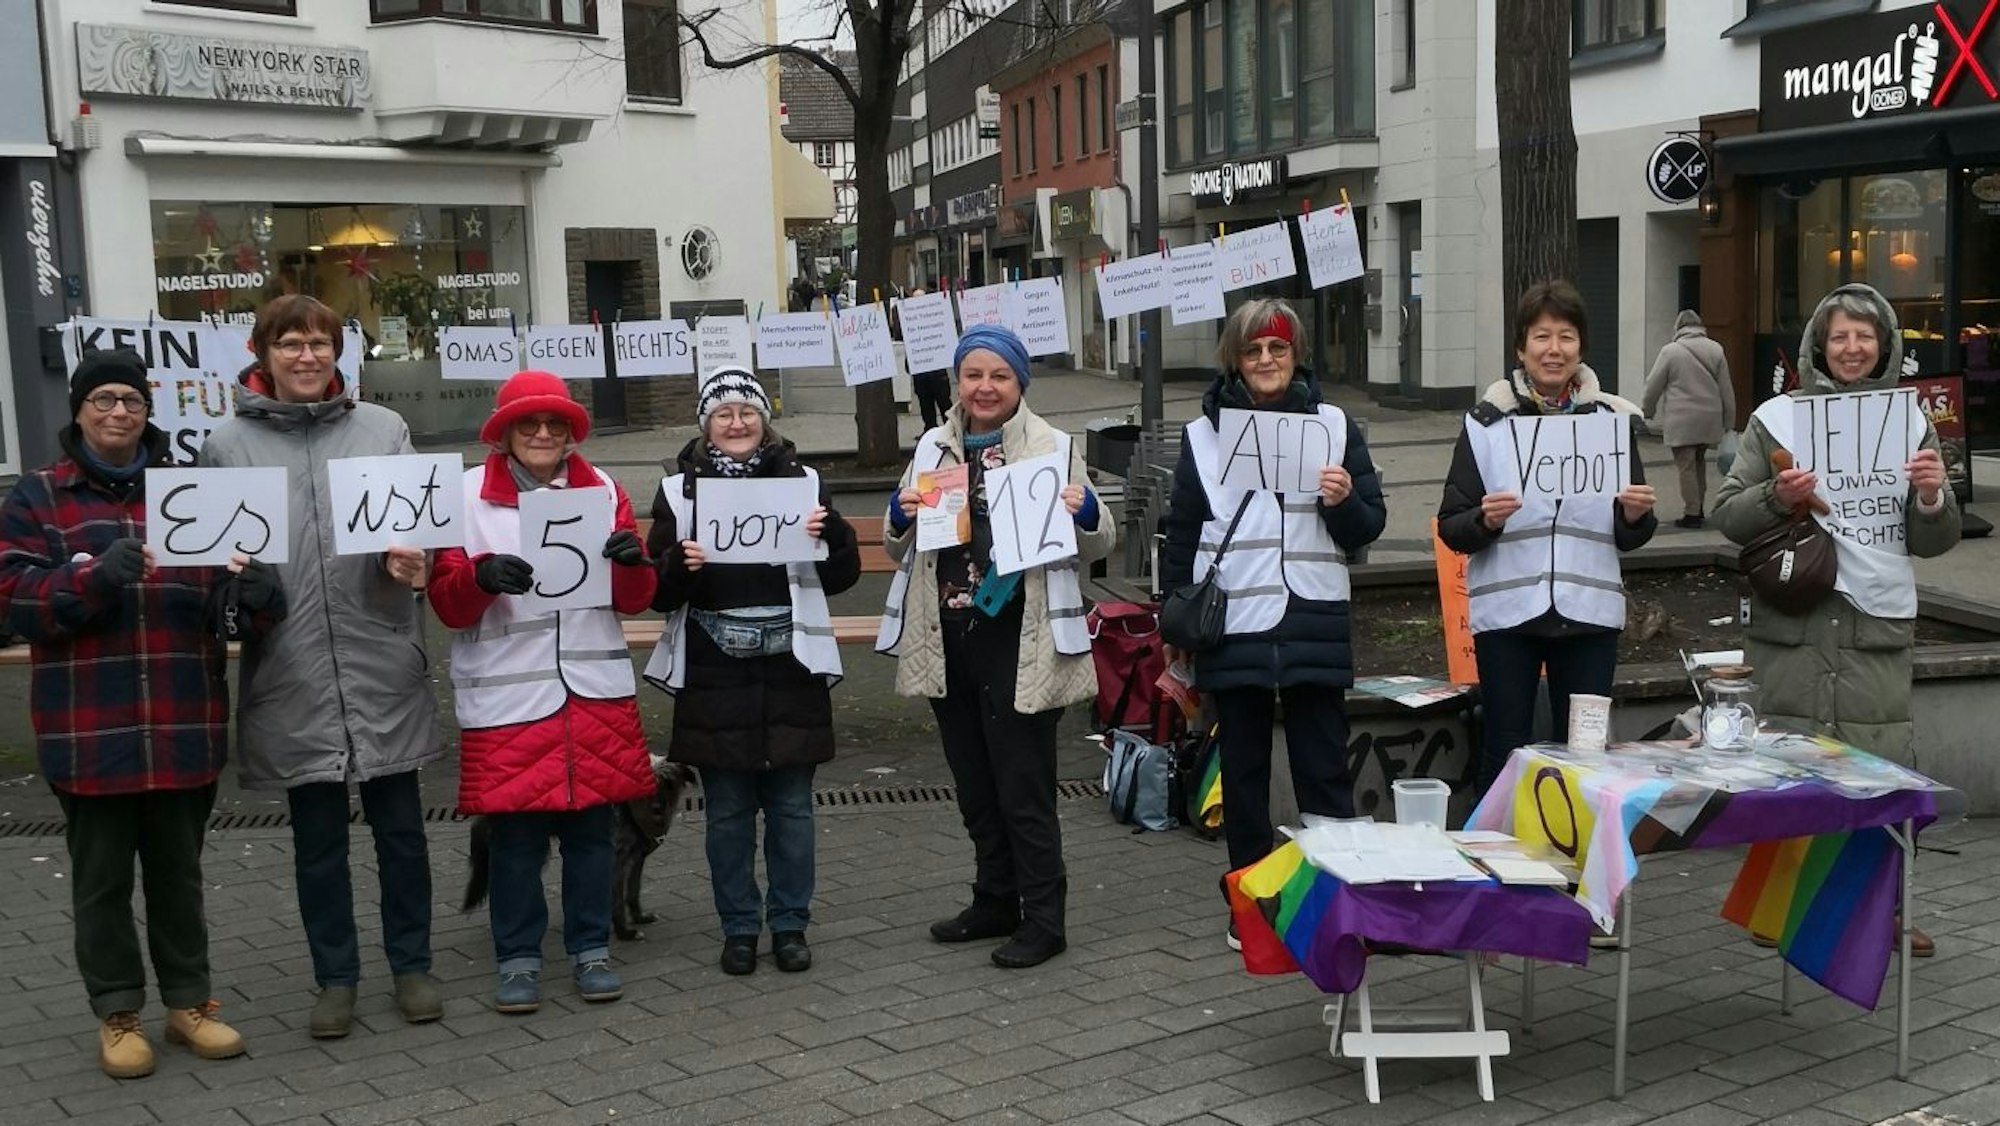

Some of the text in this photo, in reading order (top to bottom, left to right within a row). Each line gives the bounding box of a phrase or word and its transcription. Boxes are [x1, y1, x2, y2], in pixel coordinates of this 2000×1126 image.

[313, 55, 361, 76] STAR
[1784, 33, 1908, 119] mangal
[231, 83, 339, 99] NAILS & BEAUTY
[1874, 89, 1904, 107] DÖNER
[1190, 160, 1272, 196] SMOKE NATION
[158, 272, 264, 292] NAGELSTUDIO
[438, 272, 520, 289] NAGELSTUDIO
[1105, 268, 1152, 283] Klimaschutz
[1230, 257, 1281, 284] BUNT
[1024, 291, 1050, 301] Gegen
[200, 310, 257, 325] bei uns
[467, 305, 511, 320] bei uns
[1028, 306, 1050, 316] jeden
[761, 324, 826, 334] Menschenrechte
[446, 342, 514, 363] OMAS
[530, 336, 596, 359] GEGEN
[617, 330, 688, 361] RECHTS
[177, 371, 238, 418] FÜ
[1794, 389, 1917, 474] JETZT
[1220, 414, 1331, 493] AfD
[1510, 417, 1625, 497] Verbot
[1826, 474, 1897, 492] OMAS
[348, 464, 450, 533] ist
[160, 483, 270, 555] Es
[990, 466, 1064, 562] 12
[709, 513, 800, 552] vor
[535, 514, 588, 598] 5
